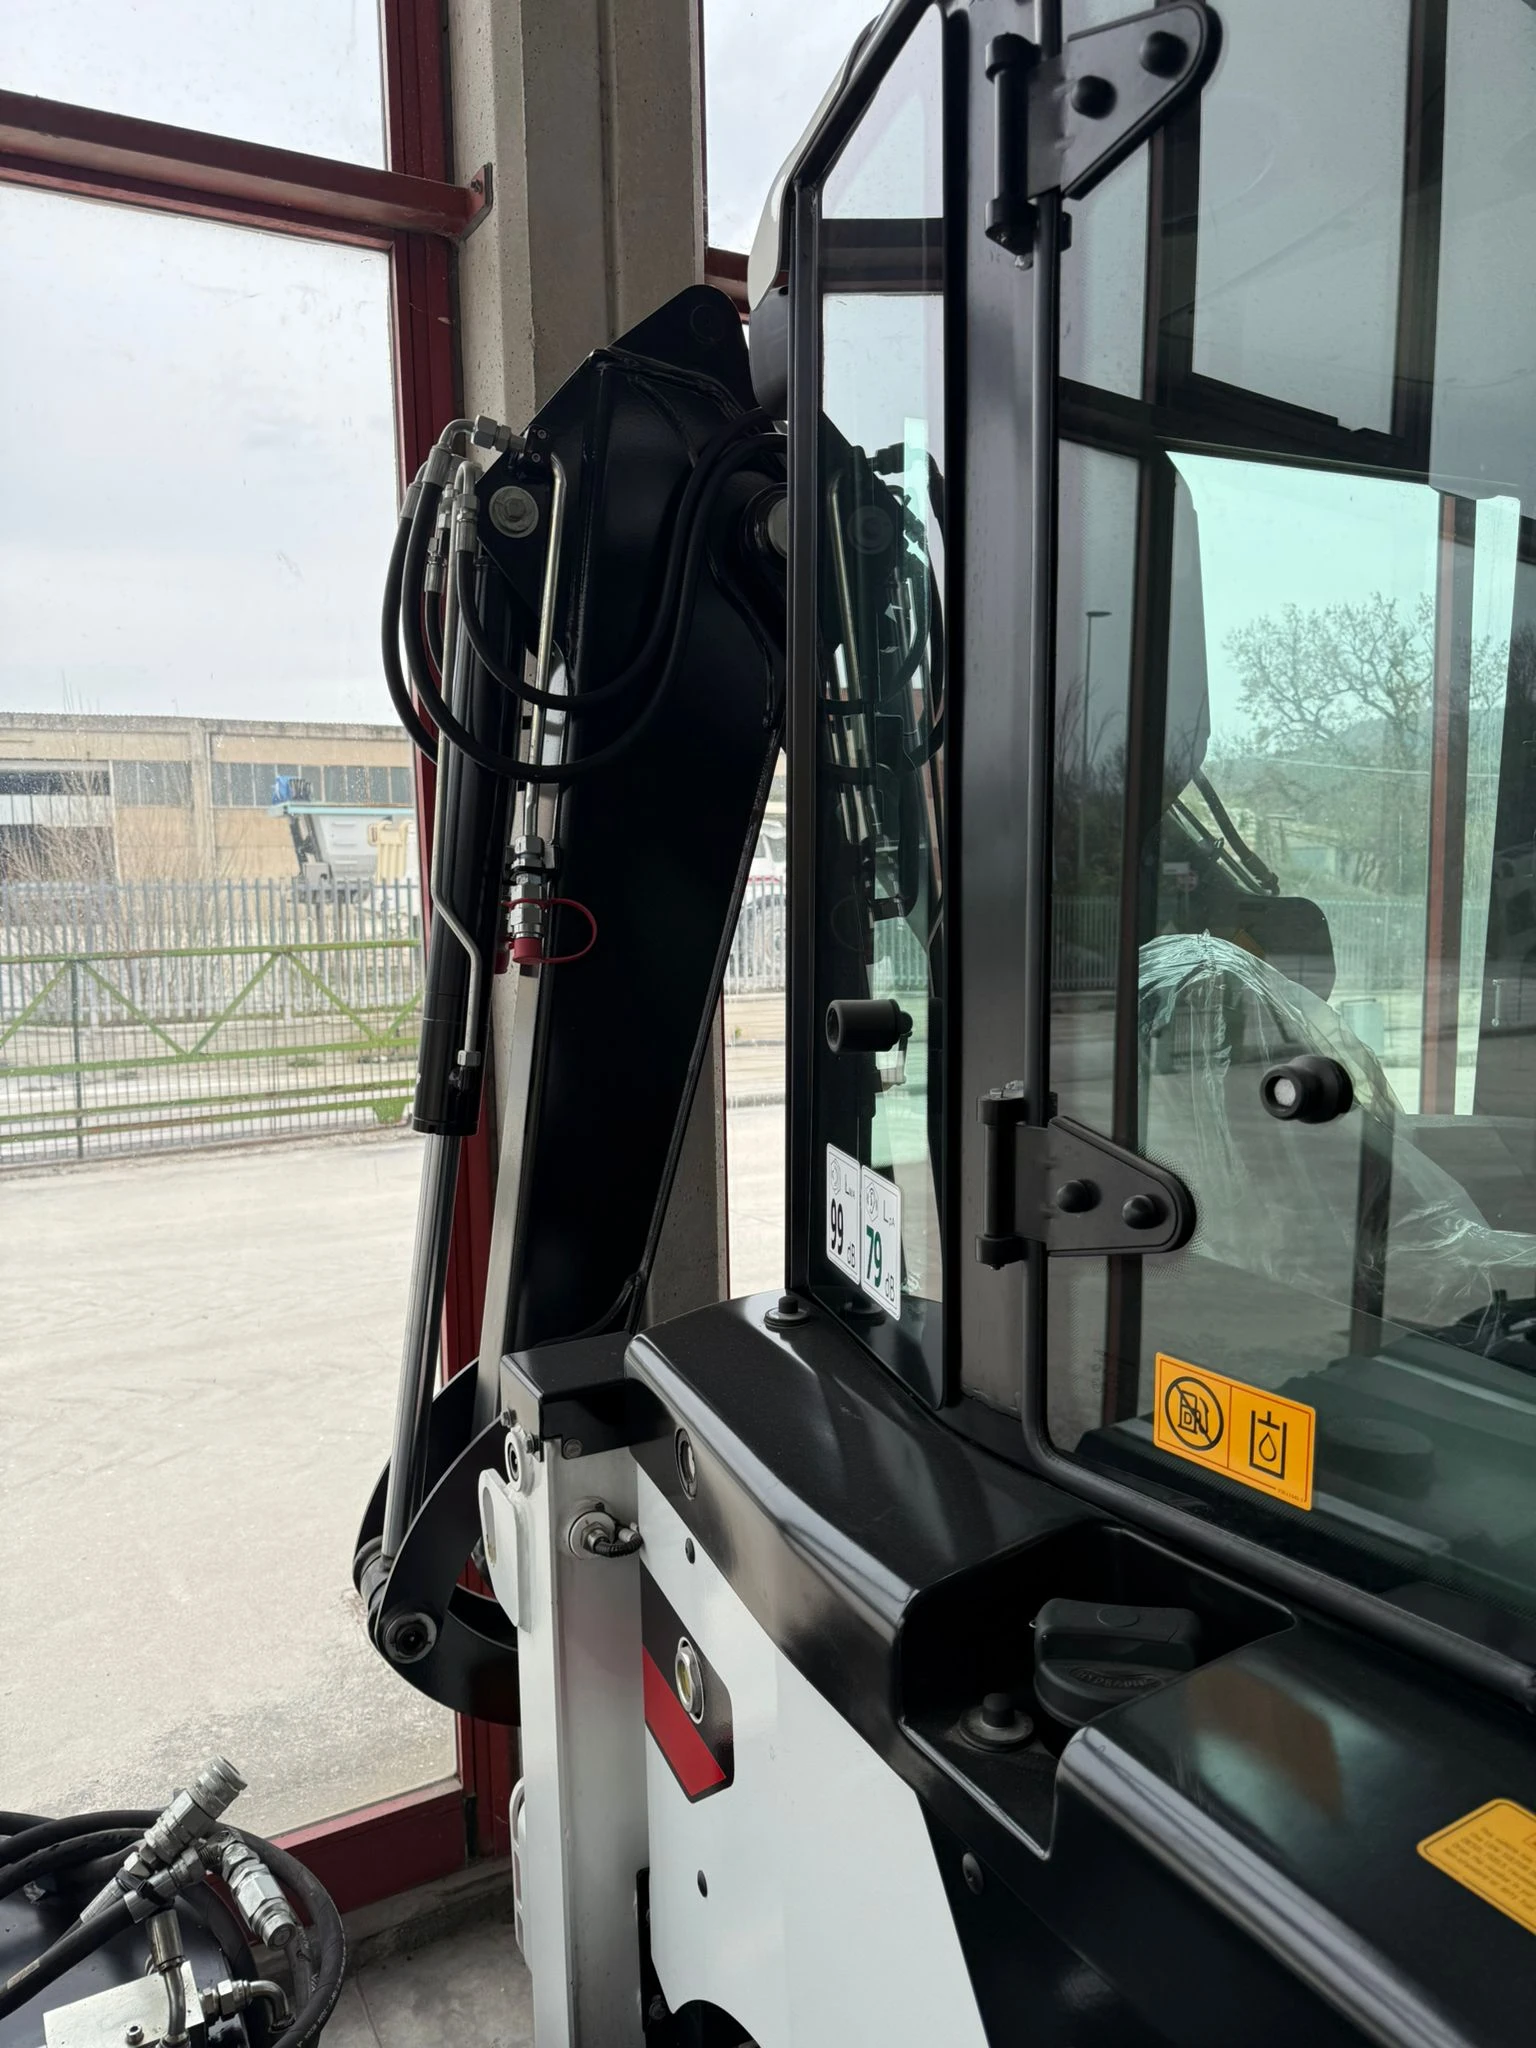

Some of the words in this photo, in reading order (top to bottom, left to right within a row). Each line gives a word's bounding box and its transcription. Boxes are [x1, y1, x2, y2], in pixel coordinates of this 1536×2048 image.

[831, 1198, 844, 1256] 99
[847, 1243, 856, 1269] dB
[866, 1224, 883, 1288] 79
[884, 1272, 896, 1302] dB
